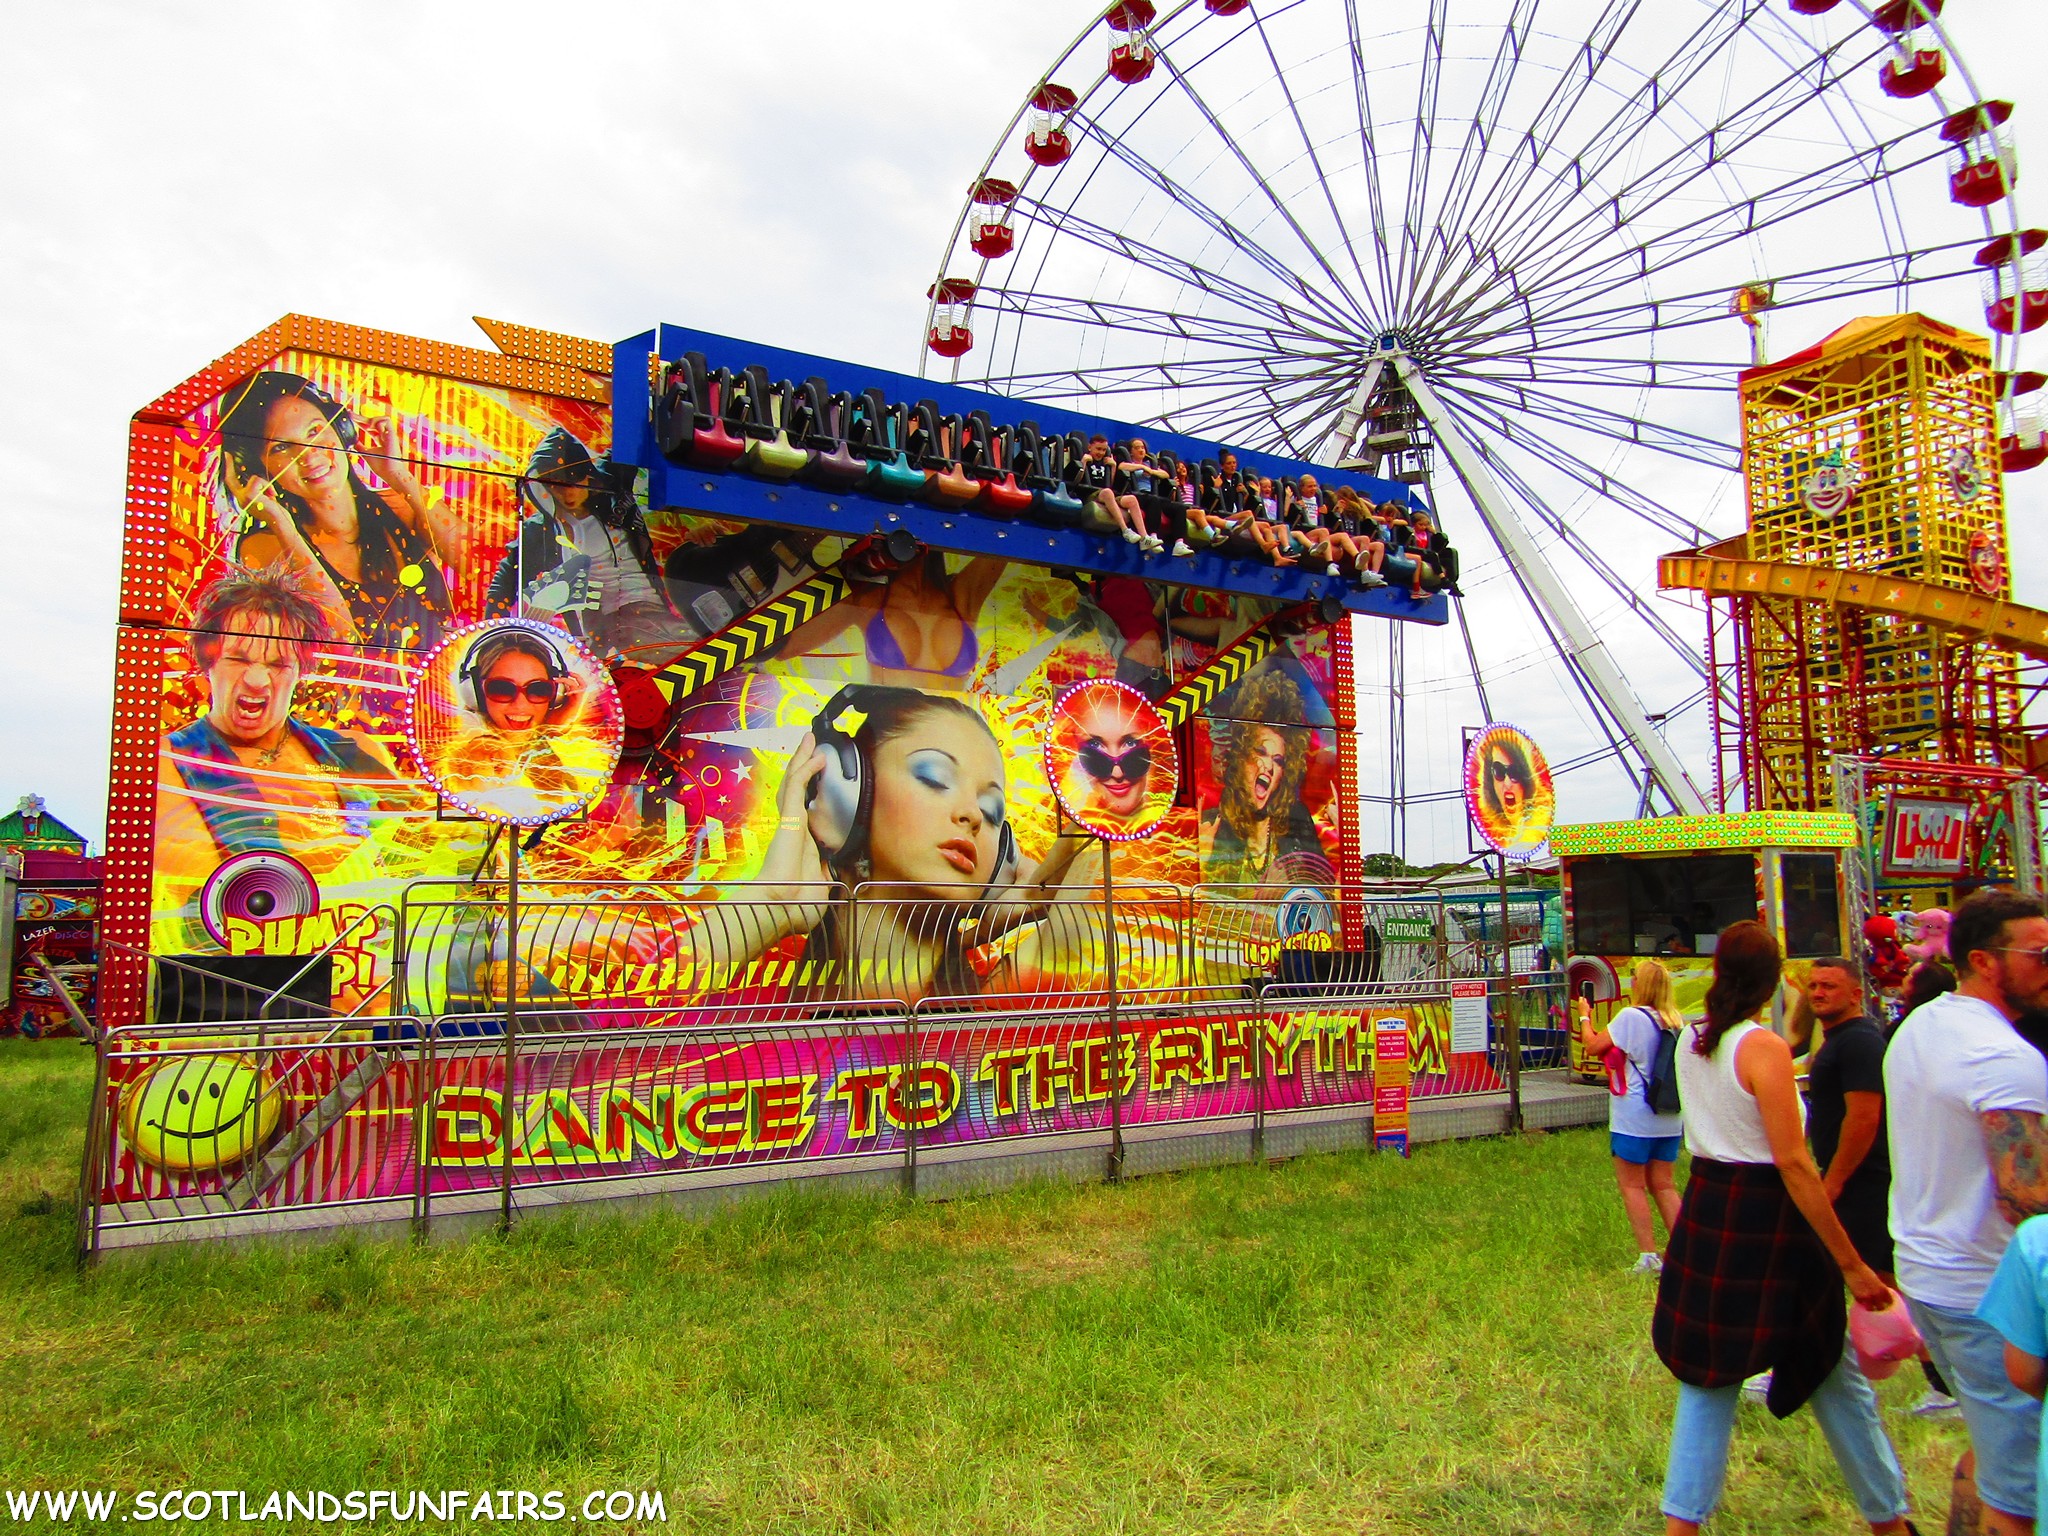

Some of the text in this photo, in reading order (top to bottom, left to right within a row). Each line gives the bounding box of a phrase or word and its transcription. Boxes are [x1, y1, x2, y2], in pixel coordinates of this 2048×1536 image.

[1906, 806, 1957, 845] FOOT
[1912, 845, 1944, 868] BALL
[22, 925, 90, 942] LAZER DISCO
[225, 904, 379, 956] PUMP
[1386, 922, 1430, 937] ENTRANCE
[422, 1074, 819, 1167] DANCE
[823, 1061, 961, 1139] TO
[970, 1032, 1142, 1117] THE
[1149, 1011, 1447, 1092] RHYTHM
